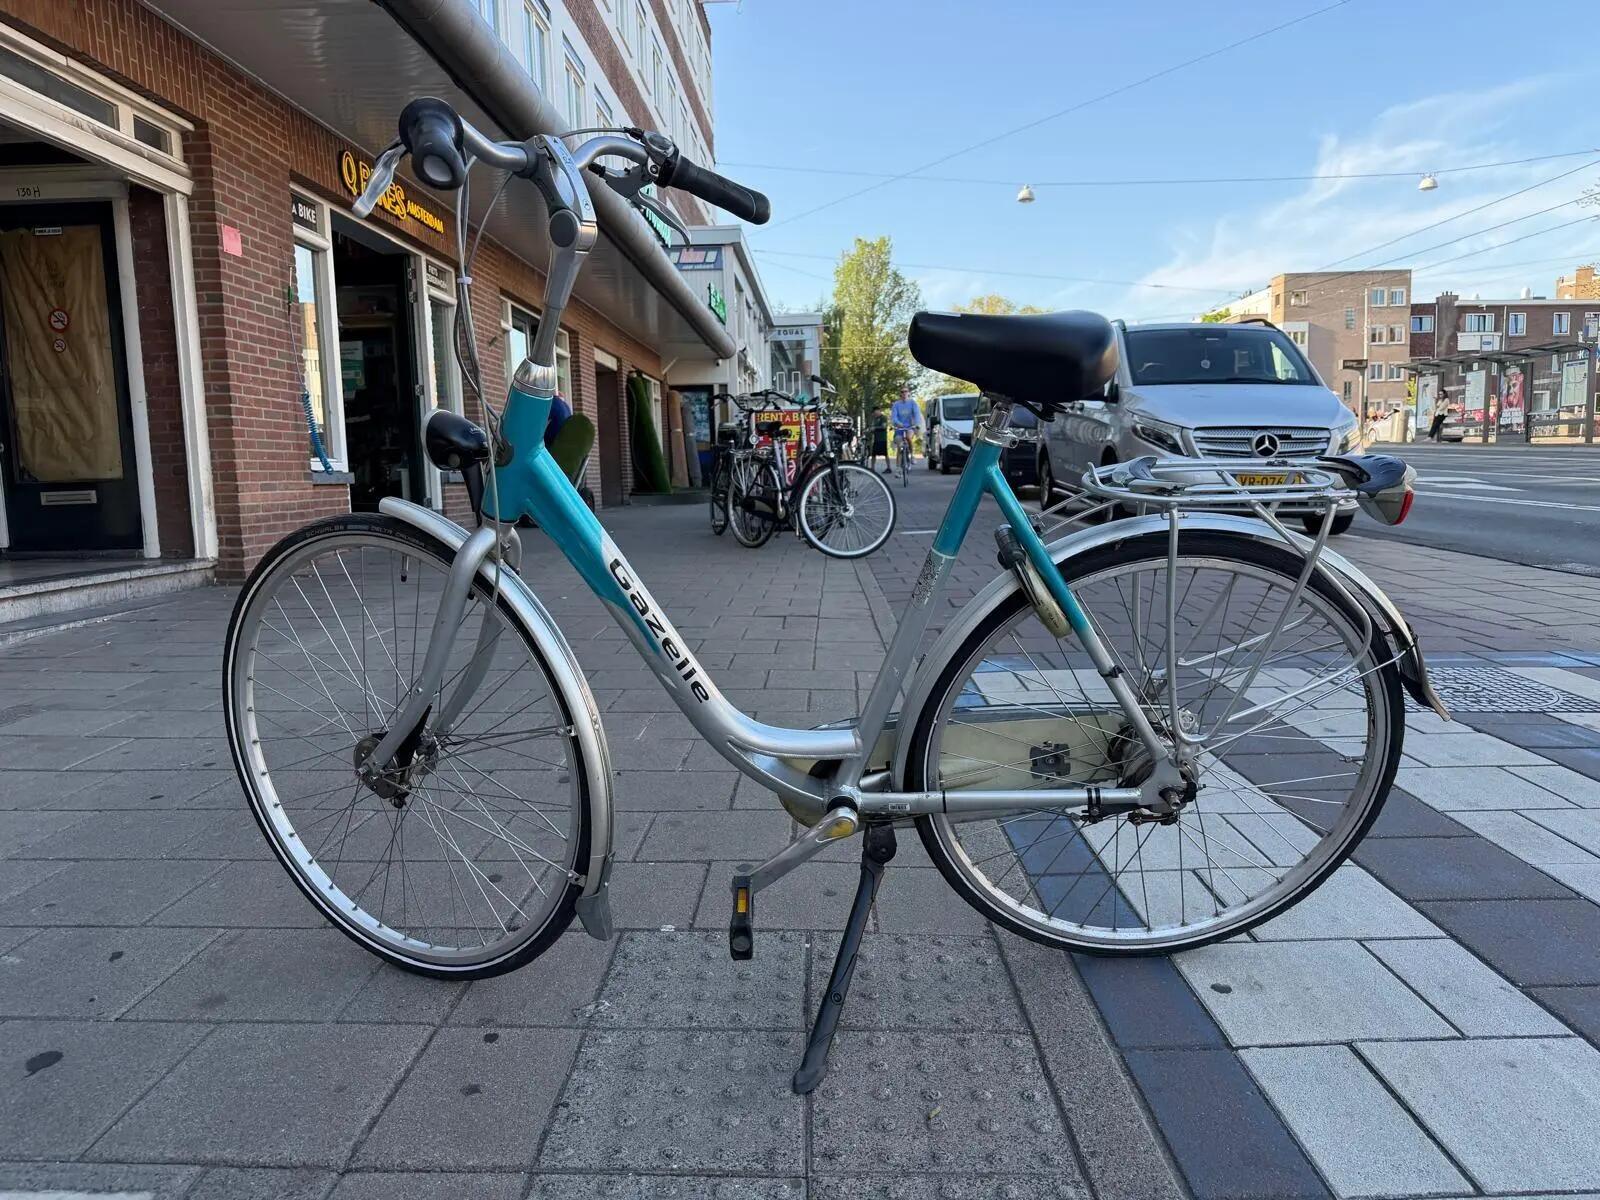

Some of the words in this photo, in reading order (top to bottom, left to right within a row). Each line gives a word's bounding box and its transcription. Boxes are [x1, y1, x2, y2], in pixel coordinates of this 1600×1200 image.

[16, 187, 31, 197] 130
[33, 185, 40, 198] H
[342, 151, 357, 196] Q
[360, 161, 406, 219] BKES
[407, 200, 443, 233] AMSTERDAM
[298, 203, 316, 224] BIKE
[757, 412, 784, 422] RENT
[792, 411, 816, 422] BKE
[609, 558, 710, 704] Gazelle
